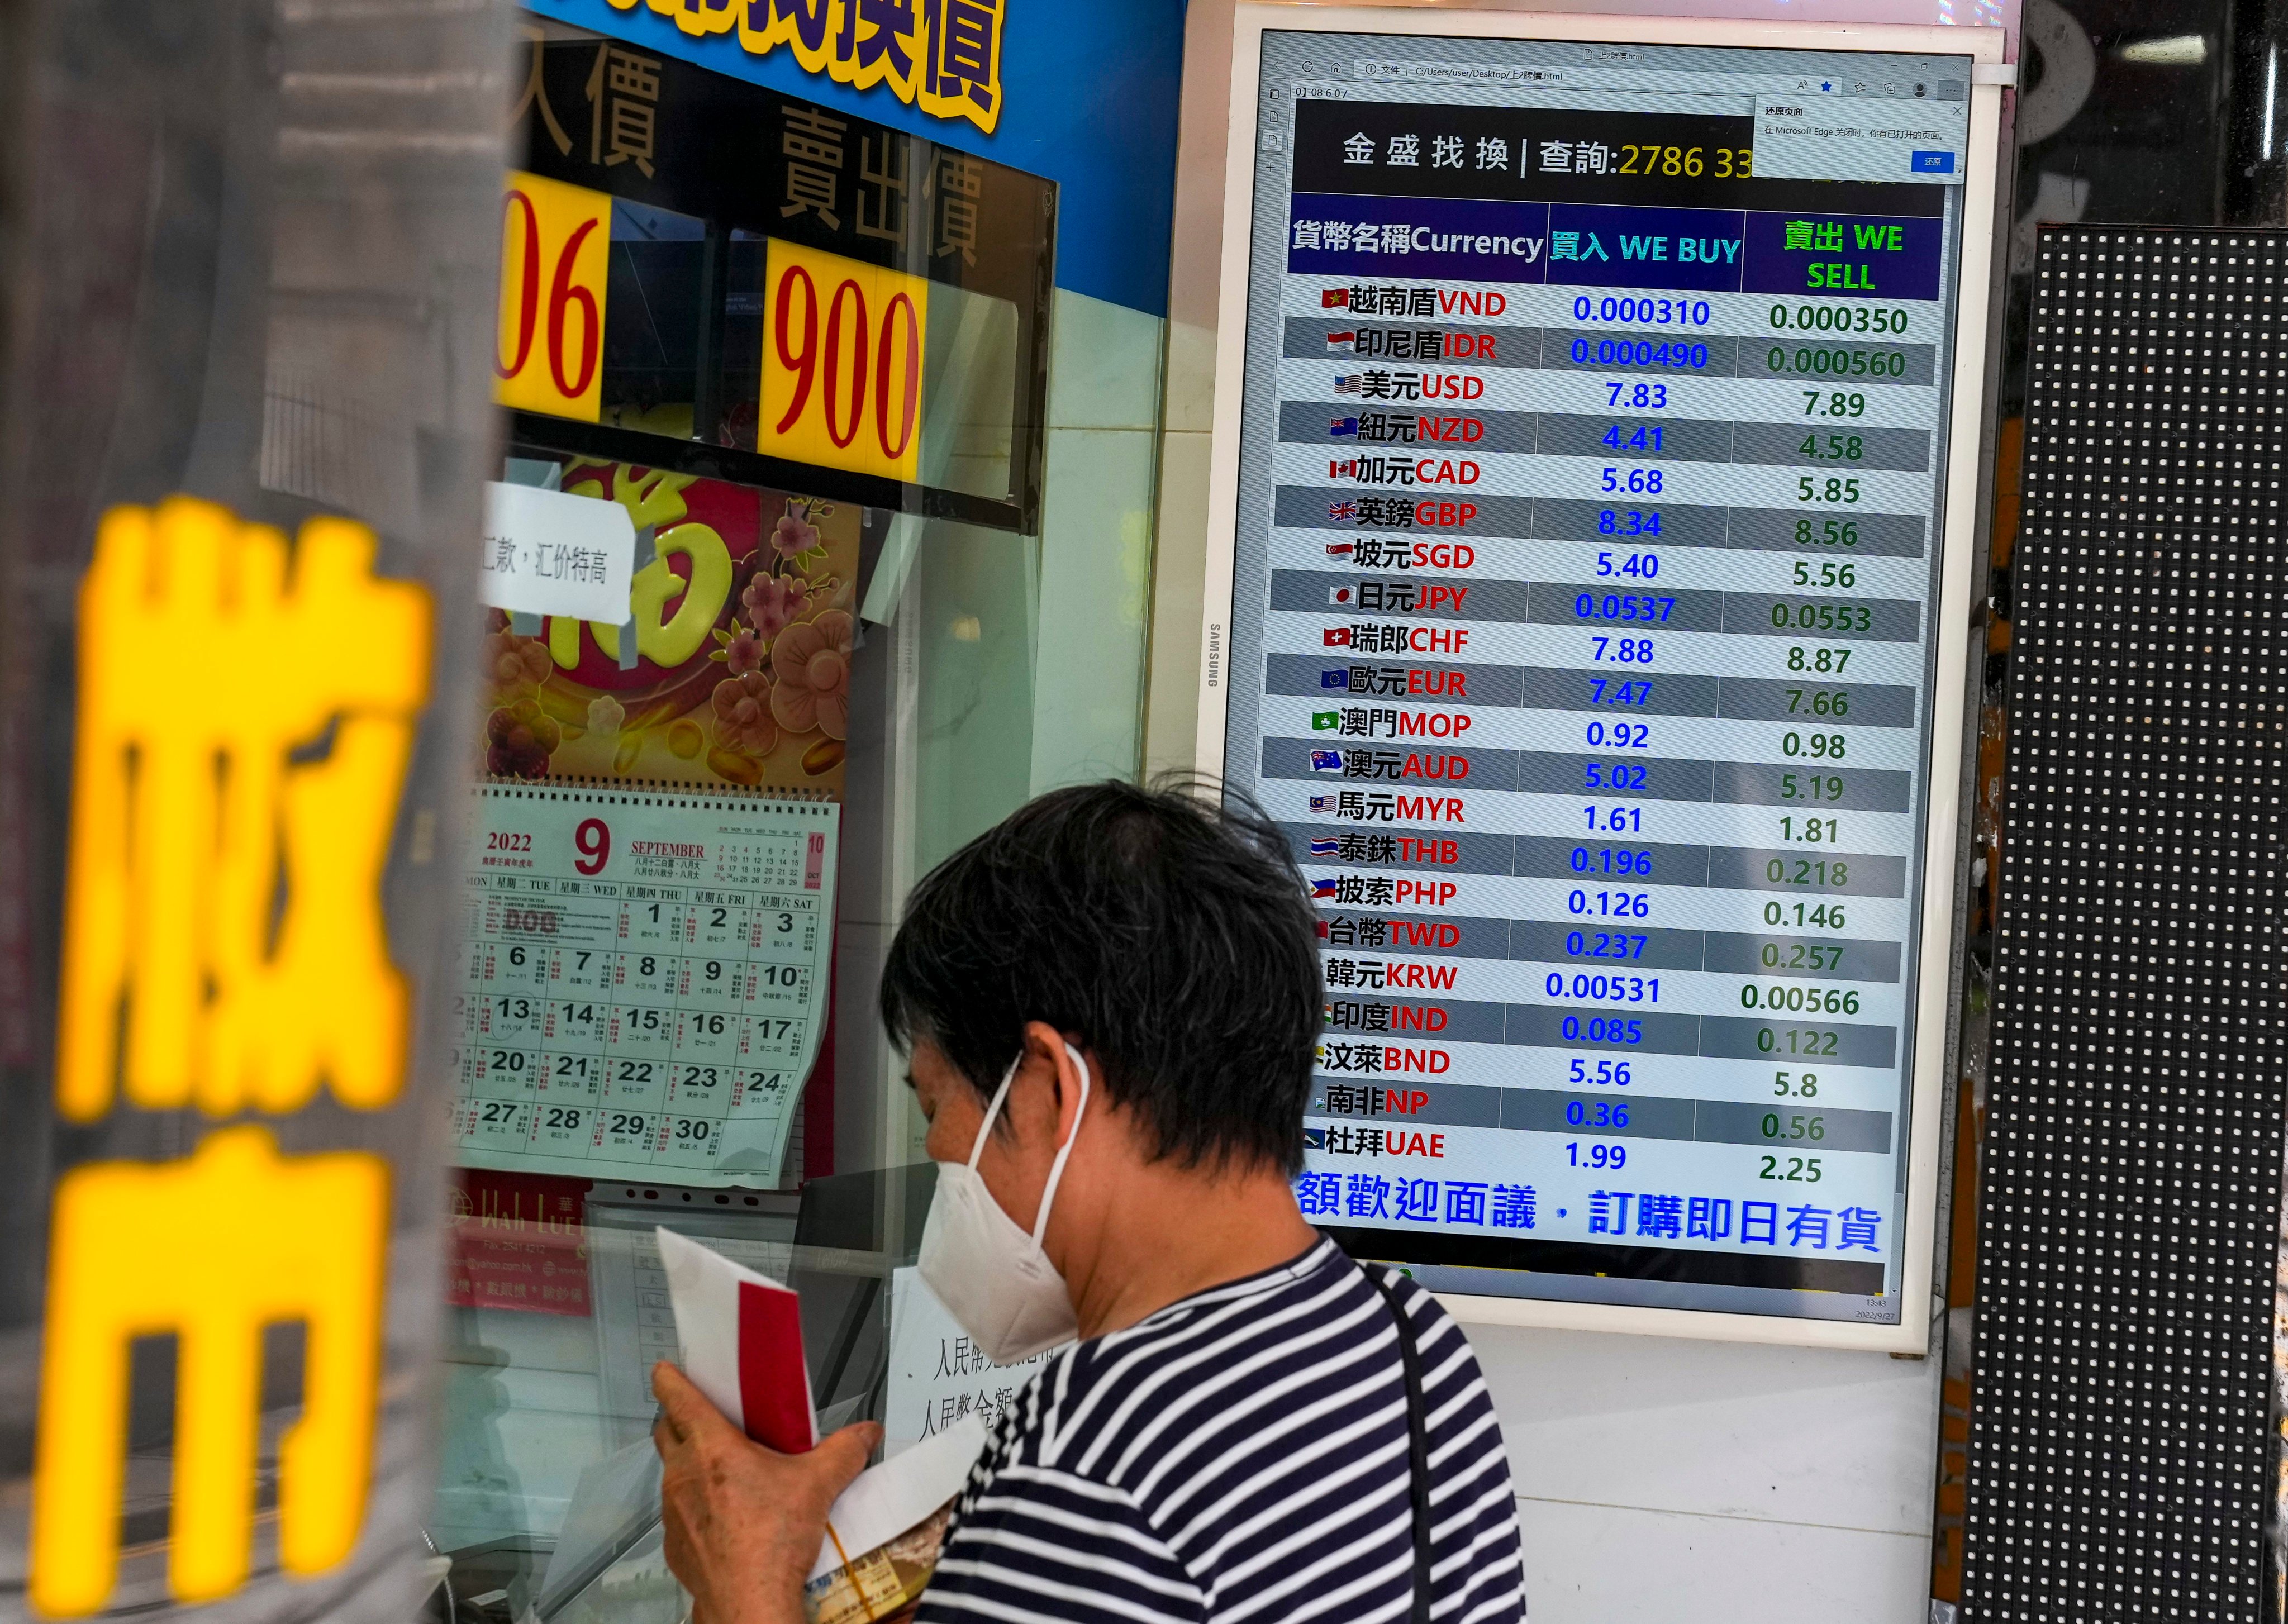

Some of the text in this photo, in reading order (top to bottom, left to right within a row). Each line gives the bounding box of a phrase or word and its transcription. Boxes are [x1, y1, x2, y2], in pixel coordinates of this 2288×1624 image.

[1381, 64, 1563, 82] 文件 C:/Users/user/Desktop/上2牌價.html
[1764, 125, 1774, 135] 在
[1776, 126, 1812, 135] Microsoft
[1814, 128, 1834, 137] Edge
[1765, 106, 1803, 116] 还原页面
[1714, 149, 1753, 178] 33
[1924, 157, 1942, 166] 还原
[780, 105, 982, 267] 賣出價
[1292, 220, 1544, 263] 貨幣名稱Currency
[1550, 231, 1742, 264] 買入 WE BUY
[1783, 220, 1904, 252] 賣出 WE
[1807, 263, 1876, 289] SELL
[1348, 284, 1907, 334] 越南盾VND 0.000310 0.000350
[775, 265, 919, 459] 900
[1355, 328, 1905, 377] 印尼盾IDR 0.000490 0.000560
[1362, 370, 1864, 417] 美元USD 7.83 7.89
[1358, 412, 1862, 460] 紐元NZD 4.41 4.58
[1357, 455, 1859, 503] 加元CAD 5.68 5.85
[1356, 497, 1857, 546] 英鎊GBP 8.34 8.56
[1353, 539, 1854, 588] 坡元SGD 5.40 5.56
[1359, 582, 1871, 631] 日元JPY 0.0537 0.0553
[1208, 623, 1220, 687] SAMSUNG
[1349, 623, 1851, 673] 瑞郎CHF 7.88 8.87
[1348, 666, 1848, 716] 歐元EUR 7.47 7.66
[1339, 707, 1844, 758] 澳門MOP 0.92 0.98
[1343, 749, 1843, 800] 澳元AUD 5.02 5.19
[1336, 792, 1835, 842] 馬元MYR 1.61 1.81
[487, 832, 532, 851] 2022
[575, 818, 610, 875] 9
[631, 840, 705, 858] SEPTEMBER
[808, 835, 824, 854] 10
[1337, 833, 1847, 885] 泰銖THB 0.196 0.218
[497, 877, 526, 889] 星期二
[530, 880, 550, 891] TUE
[560, 882, 590, 894] 星期三
[594, 885, 617, 895] WED
[626, 885, 656, 899] 星期四
[659, 889, 682, 900] THU
[695, 890, 725, 903] 星期五
[728, 894, 745, 904] FRI
[760, 895, 790, 908] 星期六
[793, 899, 814, 910] SAT
[648, 903, 659, 923] 1
[710, 908, 727, 927] 2
[777, 913, 793, 932] 3
[1335, 875, 1844, 928] 披索PHP 0.126 0.146
[510, 946, 525, 966] 6
[576, 951, 591, 970] 7
[640, 956, 655, 976] 8
[705, 961, 721, 980] 9
[764, 965, 797, 987] 10
[1329, 916, 1843, 970] 台幣TWD 0.237 0.257
[1326, 958, 1858, 1014] 韓元KRW 0.00531 0.00566
[498, 998, 792, 1040] 13 14 15 16 17
[1333, 1001, 1837, 1055] 印度IND 0.085 0.122
[491, 1050, 781, 1092] 20 21 22 23 24
[1325, 1043, 1816, 1096] 汶萊BND 5.56 5.8
[482, 1103, 709, 1140] 27 28 29 30
[1327, 1084, 1824, 1140] 南非NP 0.36 0.56
[1326, 1126, 1821, 1182] 杜拜UAE 1.99 2.25
[1855, 1311, 1895, 1320] 2022/9/27
